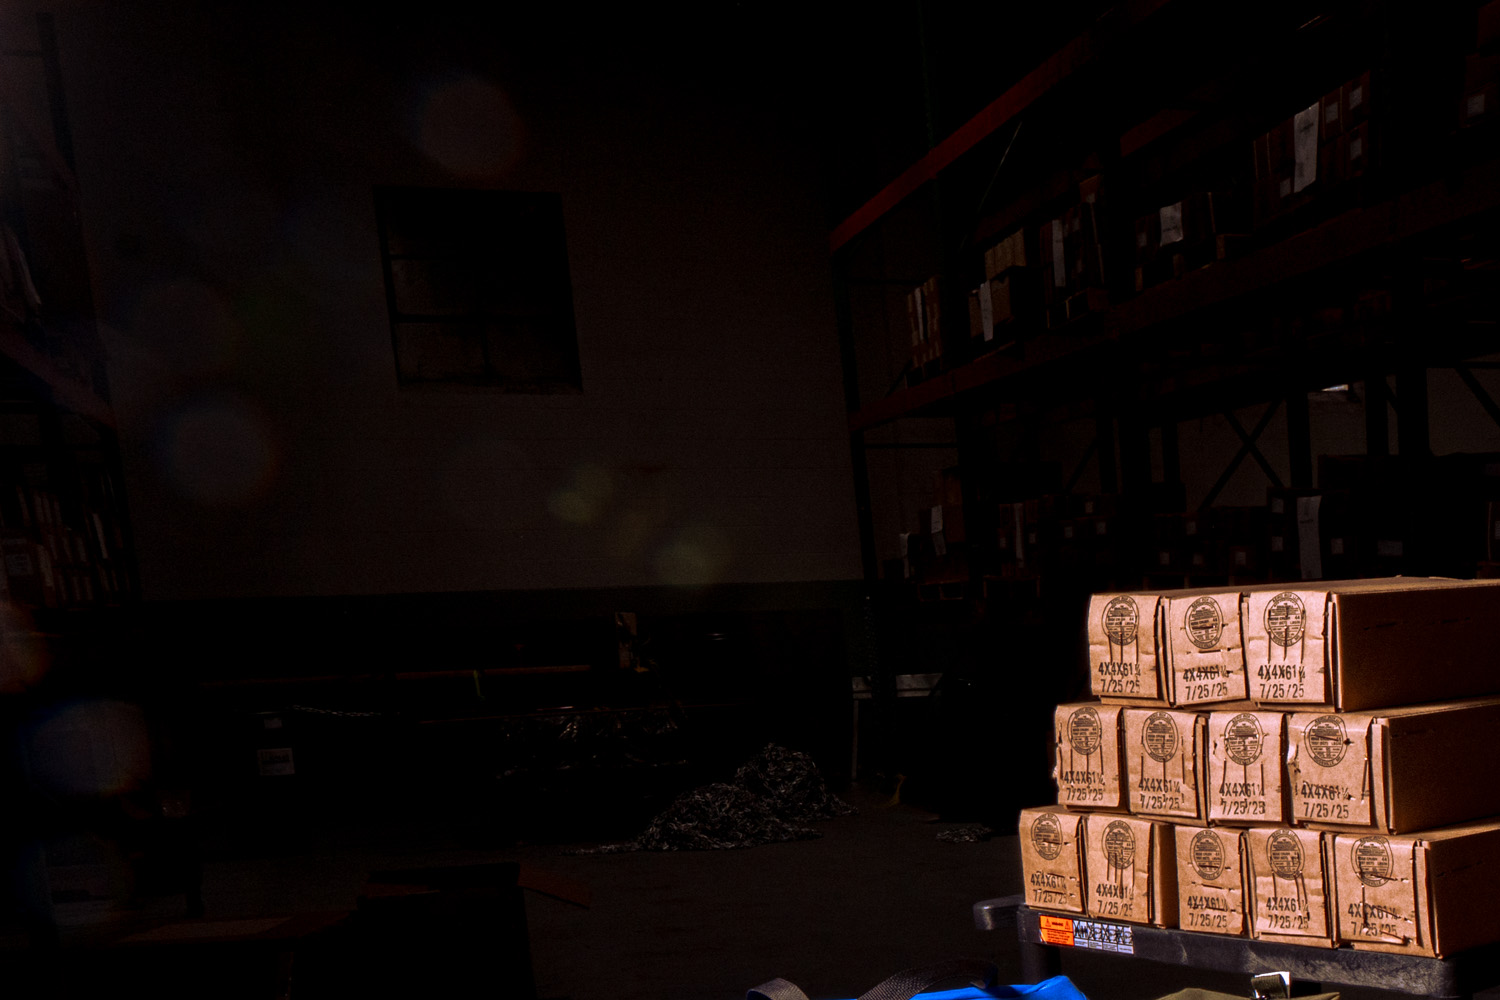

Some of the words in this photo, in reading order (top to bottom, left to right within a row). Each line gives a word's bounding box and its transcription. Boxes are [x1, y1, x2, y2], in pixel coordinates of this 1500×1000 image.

[1100, 678, 1141, 694] 7/25/25
[1185, 682, 1228, 700] 7/25/25
[1260, 683, 1305, 699] 7/25/25
[1303, 801, 1350, 819] 7/25/25
[1189, 912, 1228, 928] 7/25/25
